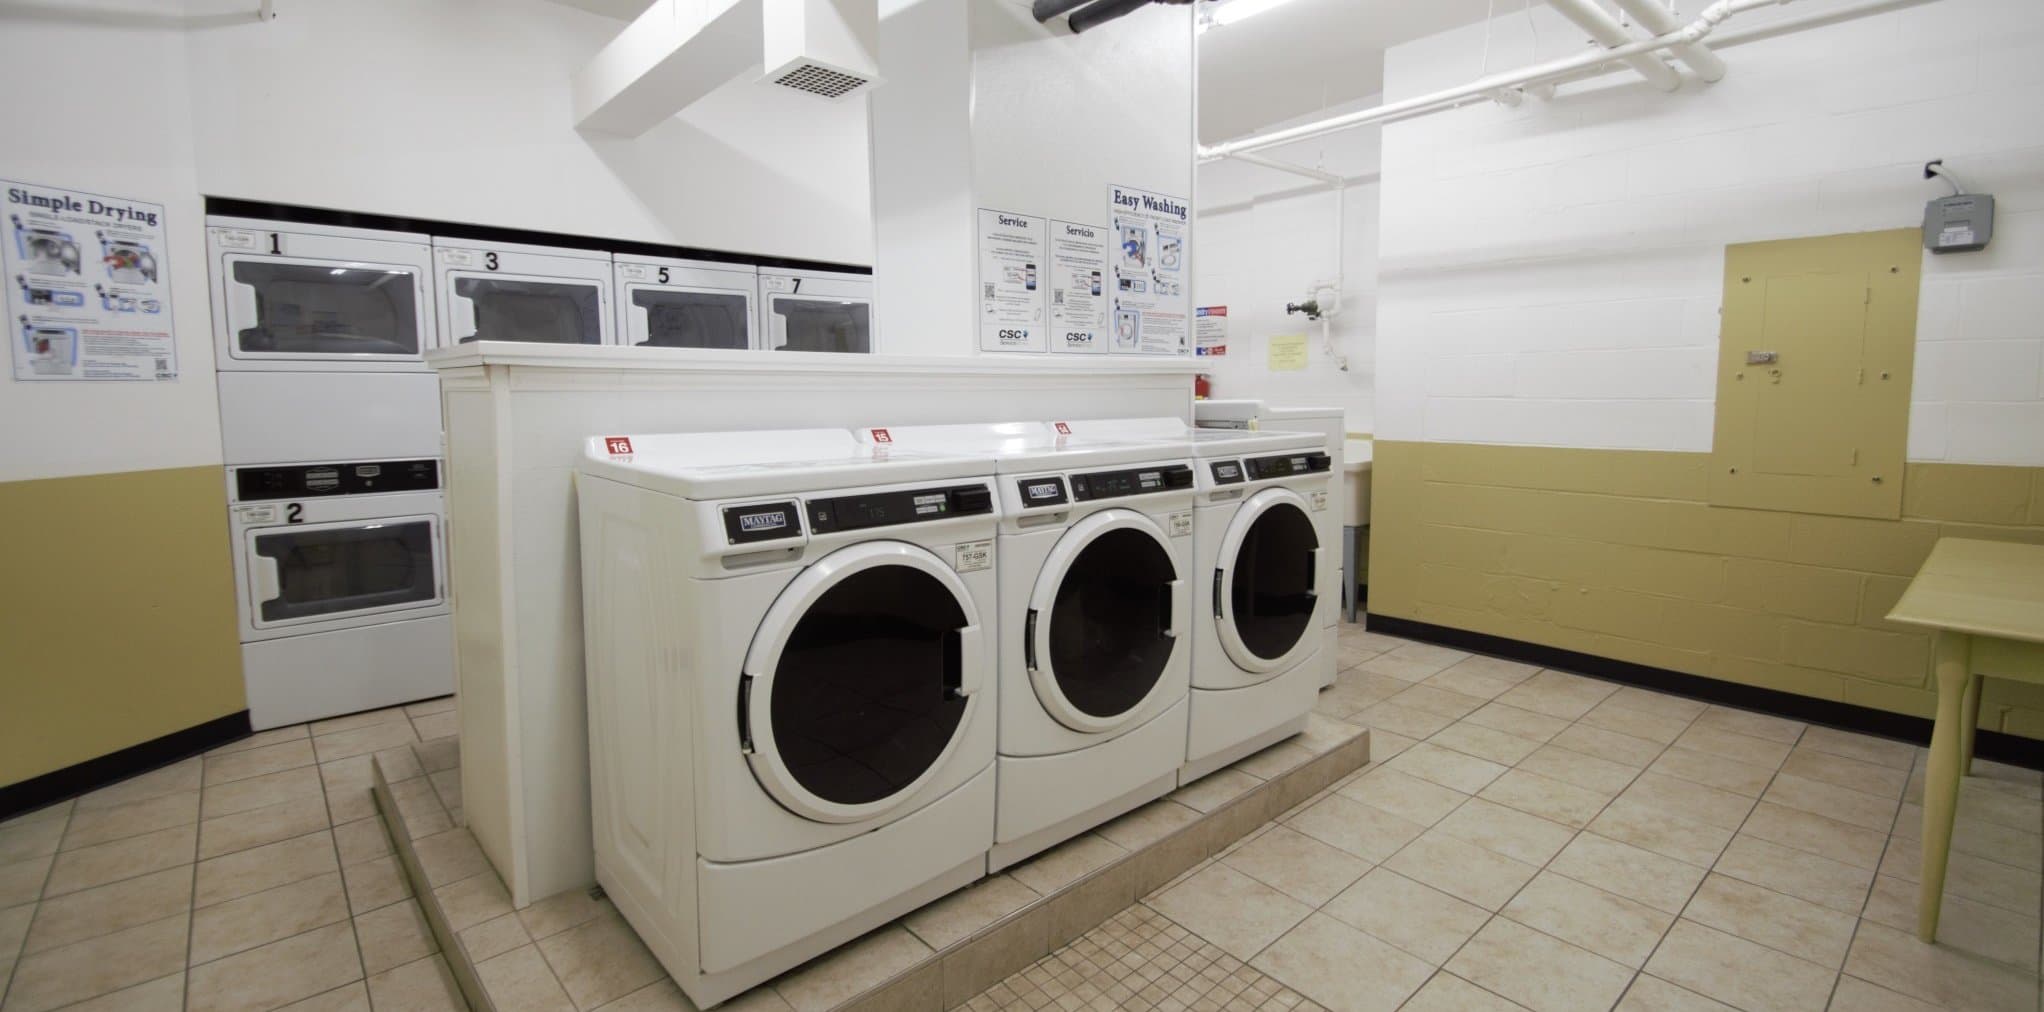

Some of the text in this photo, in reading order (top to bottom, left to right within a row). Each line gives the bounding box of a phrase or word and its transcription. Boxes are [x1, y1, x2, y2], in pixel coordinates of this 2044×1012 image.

[8, 187, 82, 213] Simple
[88, 200, 157, 226] Drying
[1114, 189, 1140, 210] Easy
[1142, 195, 1187, 220] Washing
[999, 215, 1028, 228] Service
[1066, 225, 1095, 238] Servicio
[270, 233, 282, 254] 1
[486, 252, 499, 271] 3
[658, 267, 670, 284] 5
[792, 278, 802, 294] 7
[999, 329, 1022, 339] CSC
[1066, 332, 1087, 341] CSC
[876, 432, 889, 442] 15
[610, 442, 630, 453] 16
[287, 503, 303, 523] 2
[743, 513, 784, 529] MAYTAG
